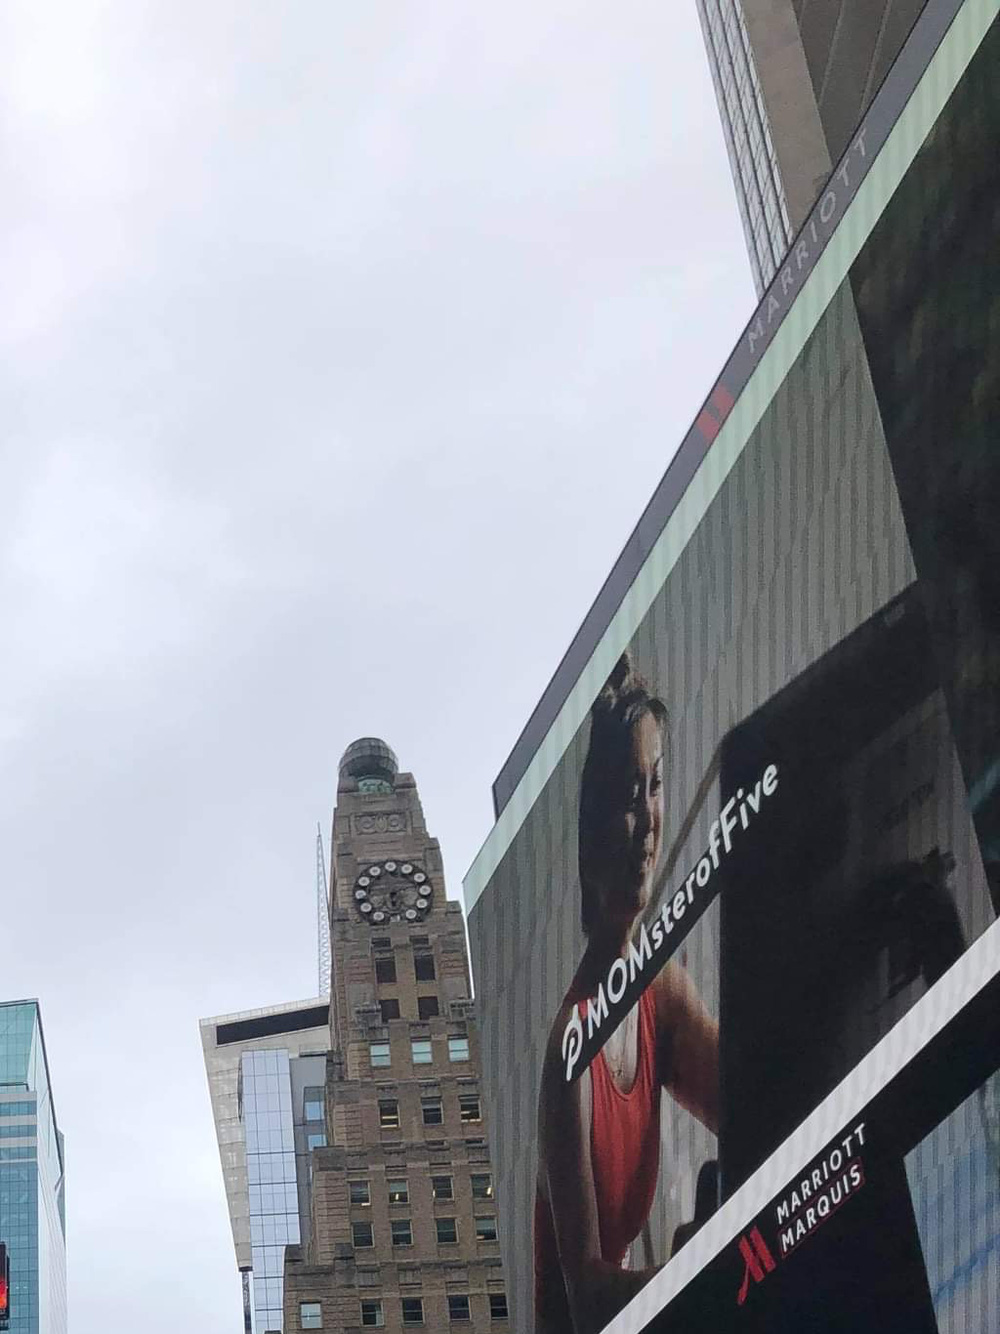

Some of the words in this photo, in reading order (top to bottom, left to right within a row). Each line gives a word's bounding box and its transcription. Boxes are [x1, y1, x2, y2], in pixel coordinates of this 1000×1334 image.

[749, 127, 866, 354] MARRIOTT
[776, 1124, 867, 1223] MARRIOTT
[781, 1163, 863, 1252] MARQUIS
